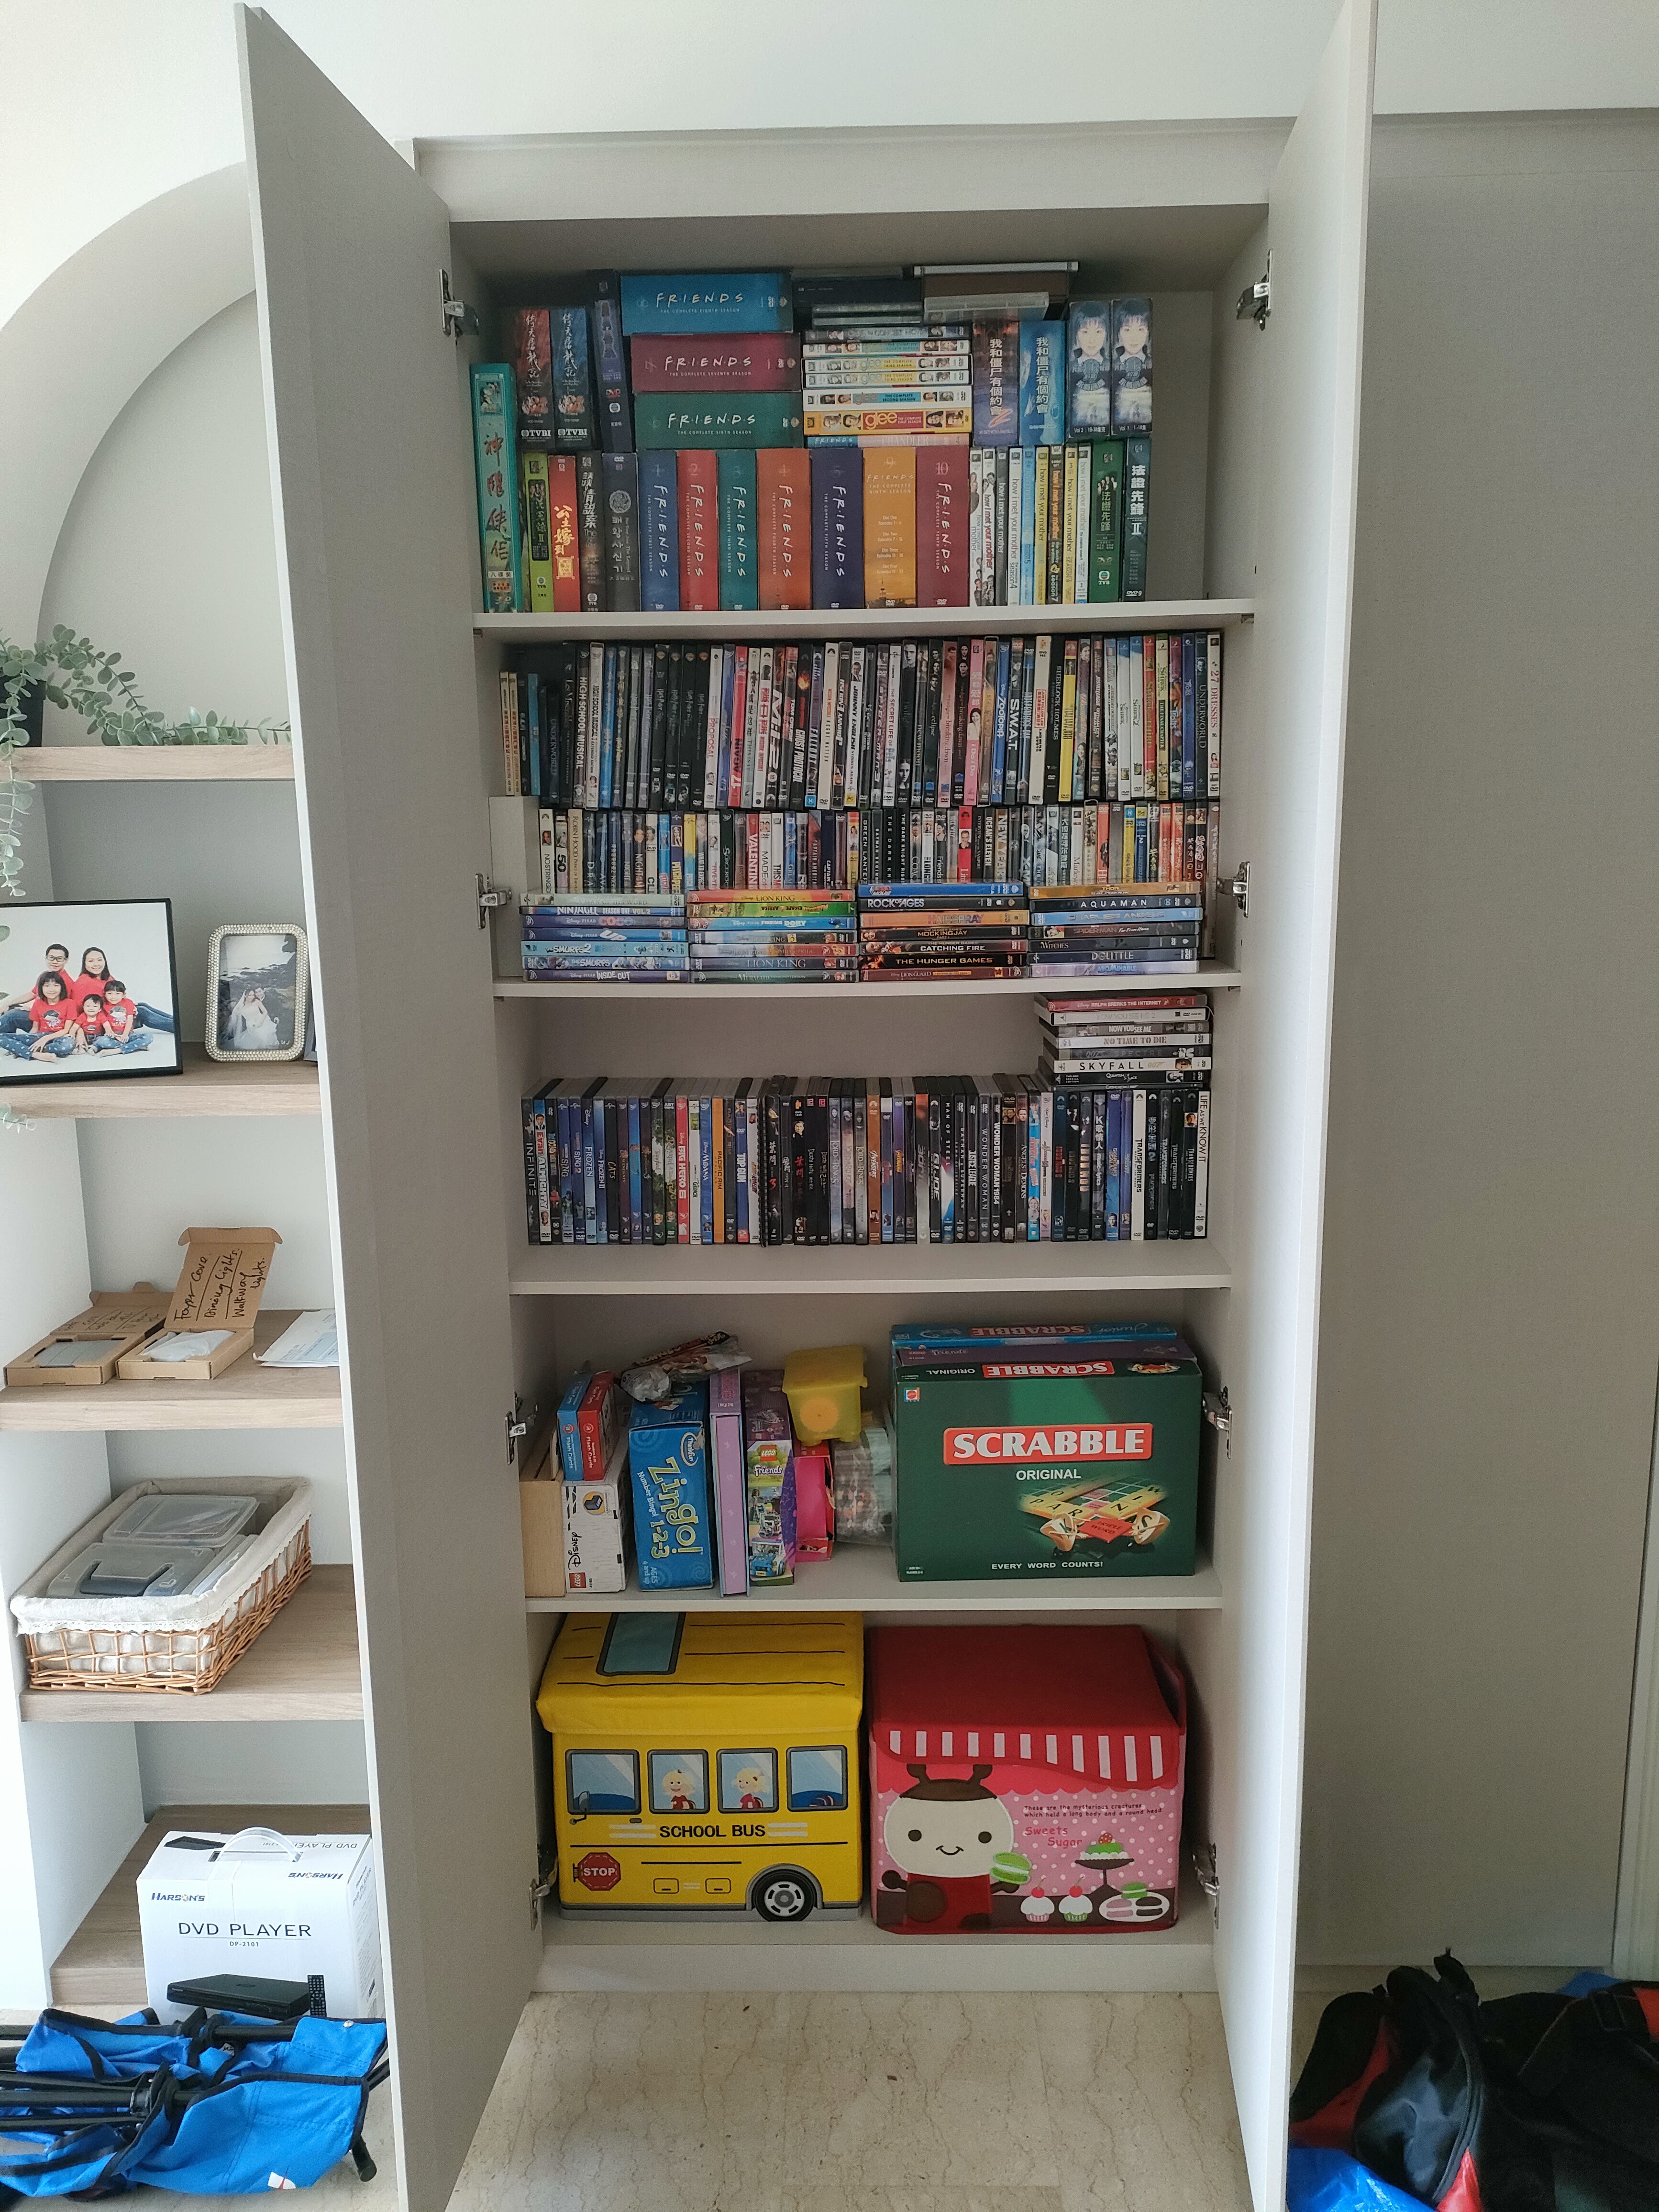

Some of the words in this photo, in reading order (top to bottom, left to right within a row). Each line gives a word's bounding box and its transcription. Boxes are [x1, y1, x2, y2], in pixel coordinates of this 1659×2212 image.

[865, 412, 897, 430] glee
[1211, 670, 1219, 682] 27
[579, 677, 587, 699] HIGH
[577, 701, 586, 733] SCHOOL
[1064, 708, 1073, 728] ITALIAN
[1198, 685, 1206, 748] UNDERWORLD
[1008, 699, 1019, 750] S.W.A.T.
[707, 718, 715, 758] PROPOSAL
[794, 730, 805, 750] GHOST
[1063, 729, 1073, 739] JOB
[576, 735, 585, 769] MUSICAL
[793, 751, 804, 783] PROTOCOL
[867, 899, 896, 907] ROCK
[899, 898, 924, 907] AGES
[1081, 899, 1147, 908] AQUAMAN
[928, 914, 984, 924] HAIRSPRAY
[747, 960, 774, 968] LION
[777, 959, 806, 968] KING
[596, 971, 617, 980] INSIDE
[617, 972, 630, 980] OUT
[1079, 1062, 1144, 1070] SKYFALL
[946, 1124, 950, 1133] OF
[1200, 1117, 1205, 1126] WE
[536, 1131, 544, 1155] Evan
[737, 1153, 746, 1167] TOP
[526, 1143, 536, 1196] INFINITE
[608, 1161, 616, 1179] CATS
[737, 1168, 746, 1183] GUN
[538, 1157, 547, 1208] ALMIGHTY
[968, 1169, 976, 1186] LEAGUE
[972, 1326, 1085, 1336] SCRABBLE
[988, 1363, 1107, 1374] SCRABBLE
[953, 1430, 1144, 1458] SCRABBLE
[754, 1465, 783, 1477] Friends
[1016, 1469, 1081, 1481] ORIGINAL
[637, 1471, 651, 1496] Number
[648, 1456, 703, 1555] Zingo!
[650, 1520, 669, 1559] 1-2-3
[659, 1825, 726, 1837] SCHOOL
[732, 1824, 766, 1837] BUS
[1025, 1826, 1068, 1835] Sweets
[1048, 1837, 1082, 1848] Sugar
[583, 1866, 616, 1876] STOP
[151, 1892, 205, 1902] HARSON'S
[178, 1923, 219, 1936] DVD
[230, 1924, 311, 1936] PLAYER
